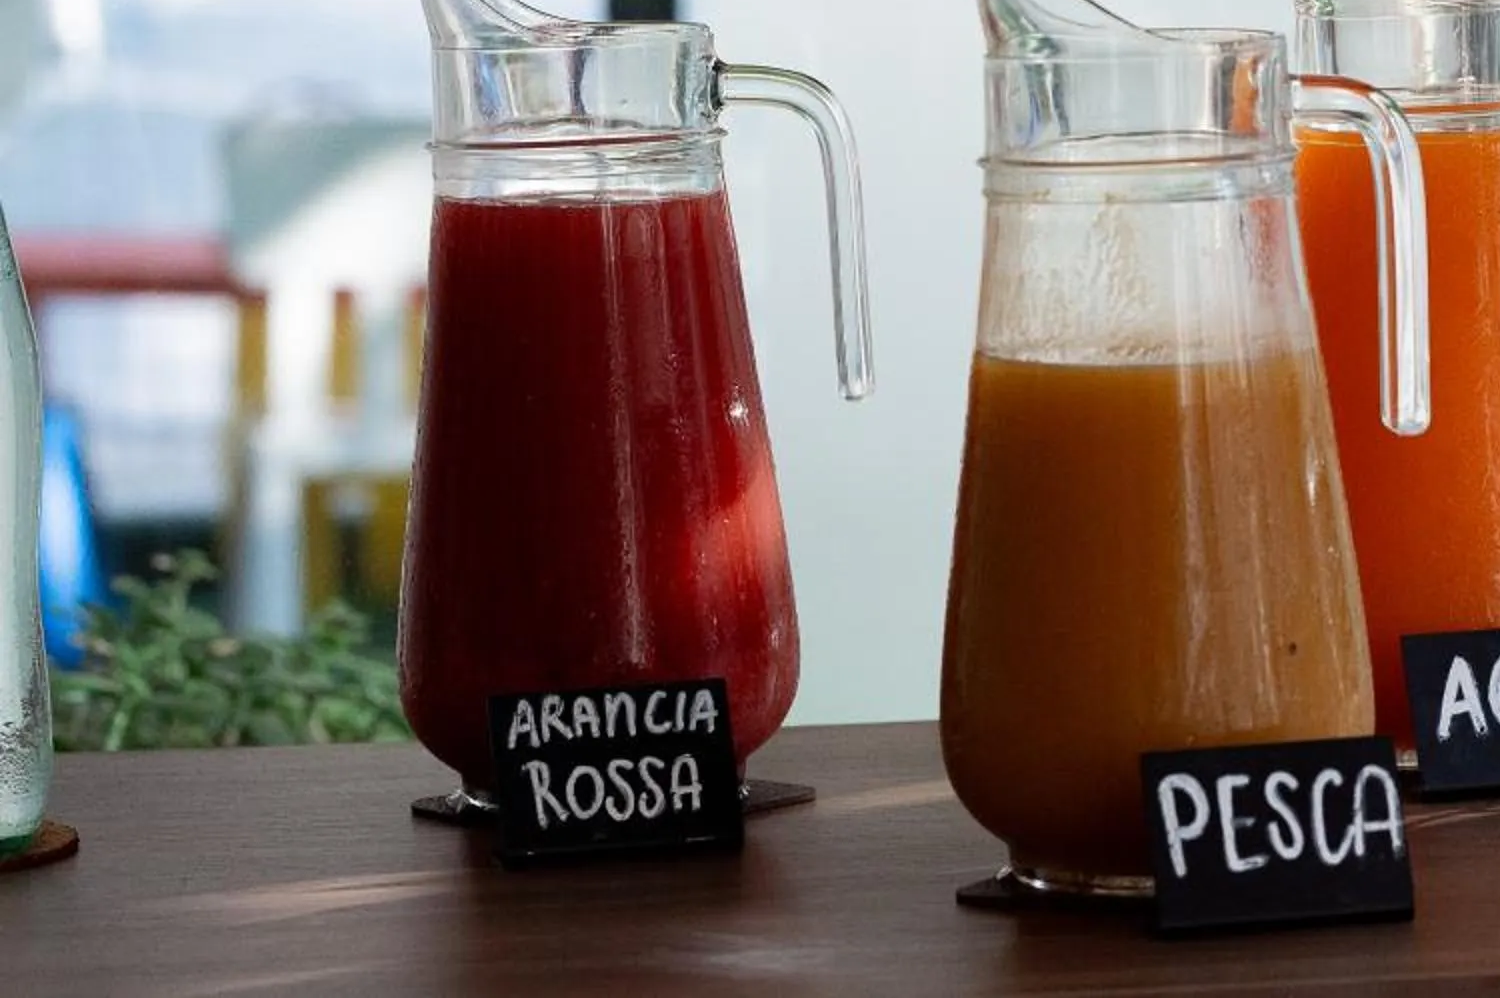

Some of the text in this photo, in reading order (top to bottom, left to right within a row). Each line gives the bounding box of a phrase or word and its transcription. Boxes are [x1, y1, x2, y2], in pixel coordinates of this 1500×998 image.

[508, 689, 718, 749] ARANCIA
[521, 754, 702, 829] ROSSA
[1158, 764, 1405, 878] PESCA
